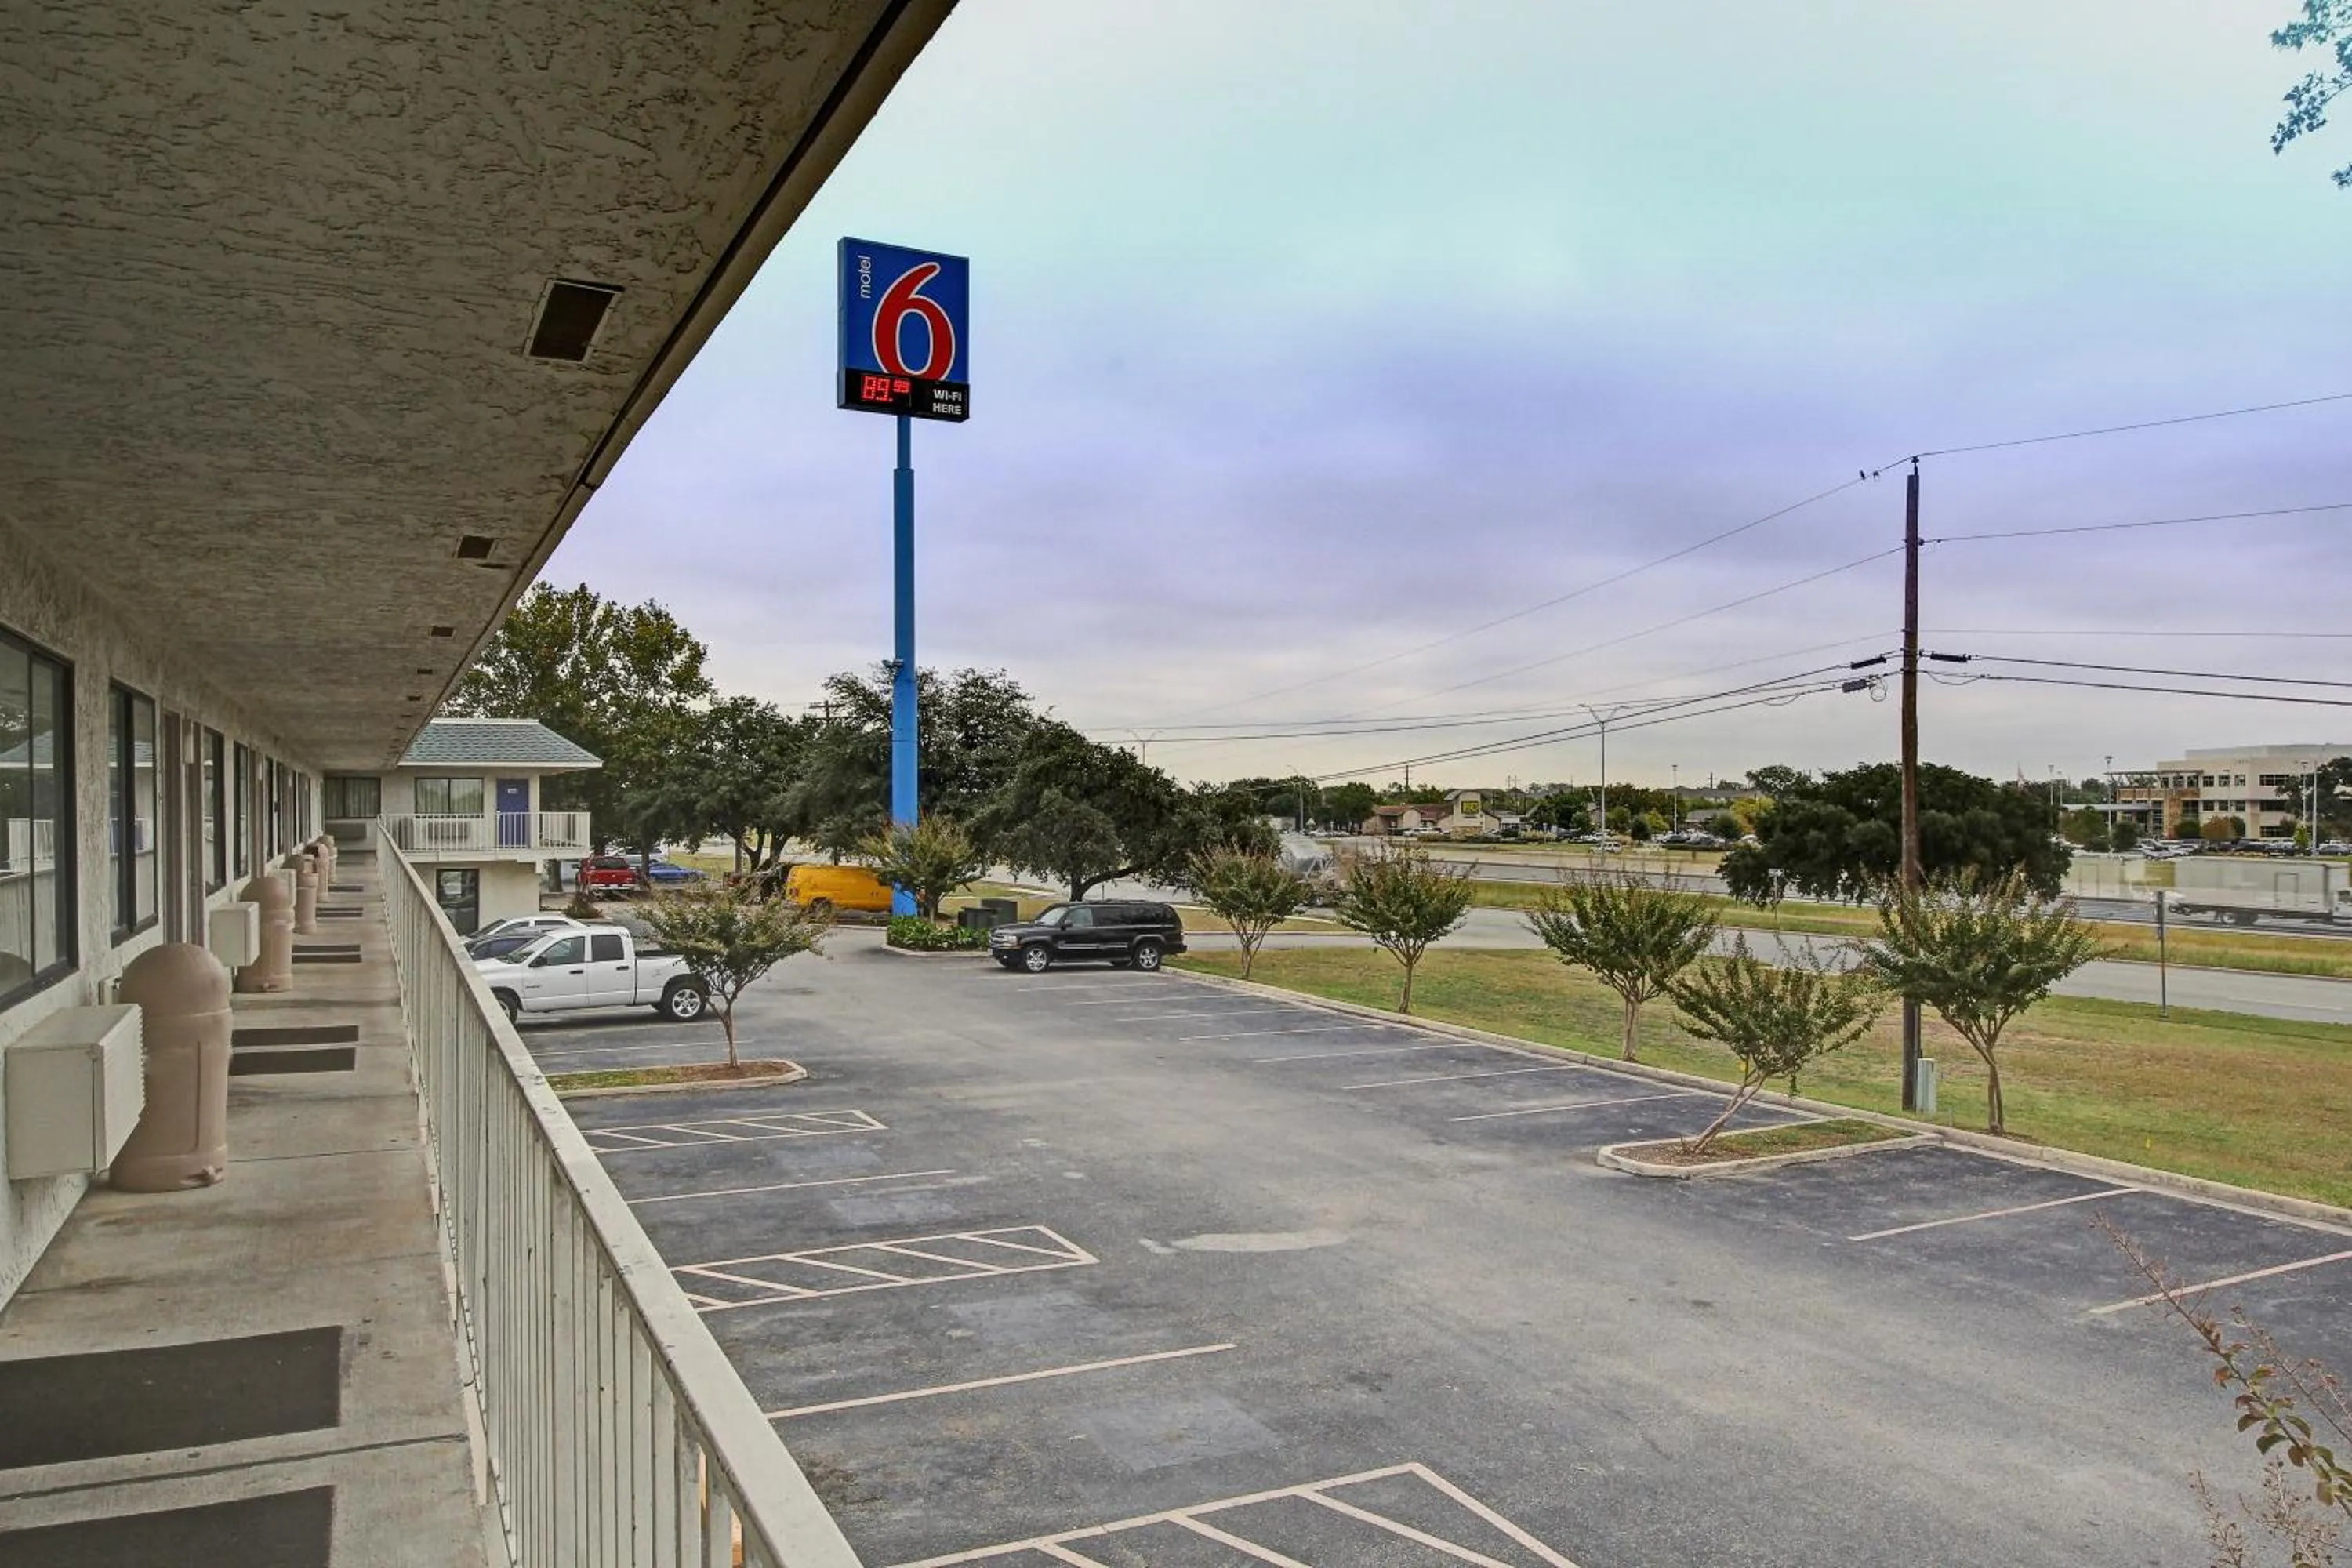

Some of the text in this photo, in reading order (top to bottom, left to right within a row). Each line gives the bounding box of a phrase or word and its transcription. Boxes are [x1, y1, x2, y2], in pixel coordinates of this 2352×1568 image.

[858, 255, 871, 299] motel
[872, 261, 956, 382] 6
[932, 402, 962, 415] HERE
[933, 388, 962, 401] WI-FI
